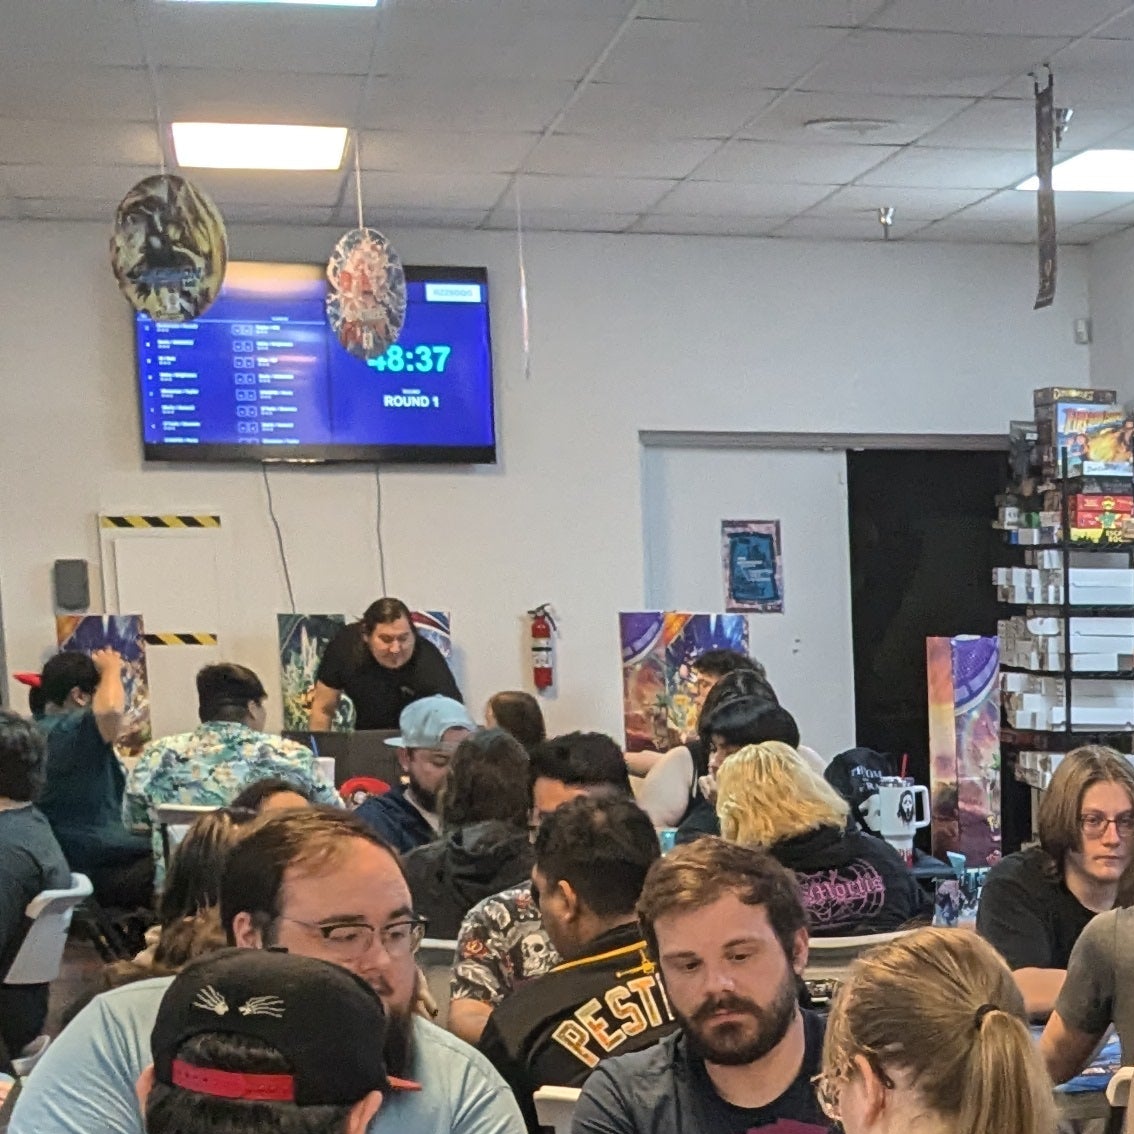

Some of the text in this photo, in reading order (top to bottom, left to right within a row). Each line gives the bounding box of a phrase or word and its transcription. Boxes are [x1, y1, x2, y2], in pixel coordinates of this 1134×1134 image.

[383, 395, 439, 408] ROUND 1
[551, 972, 676, 1069] PEST
